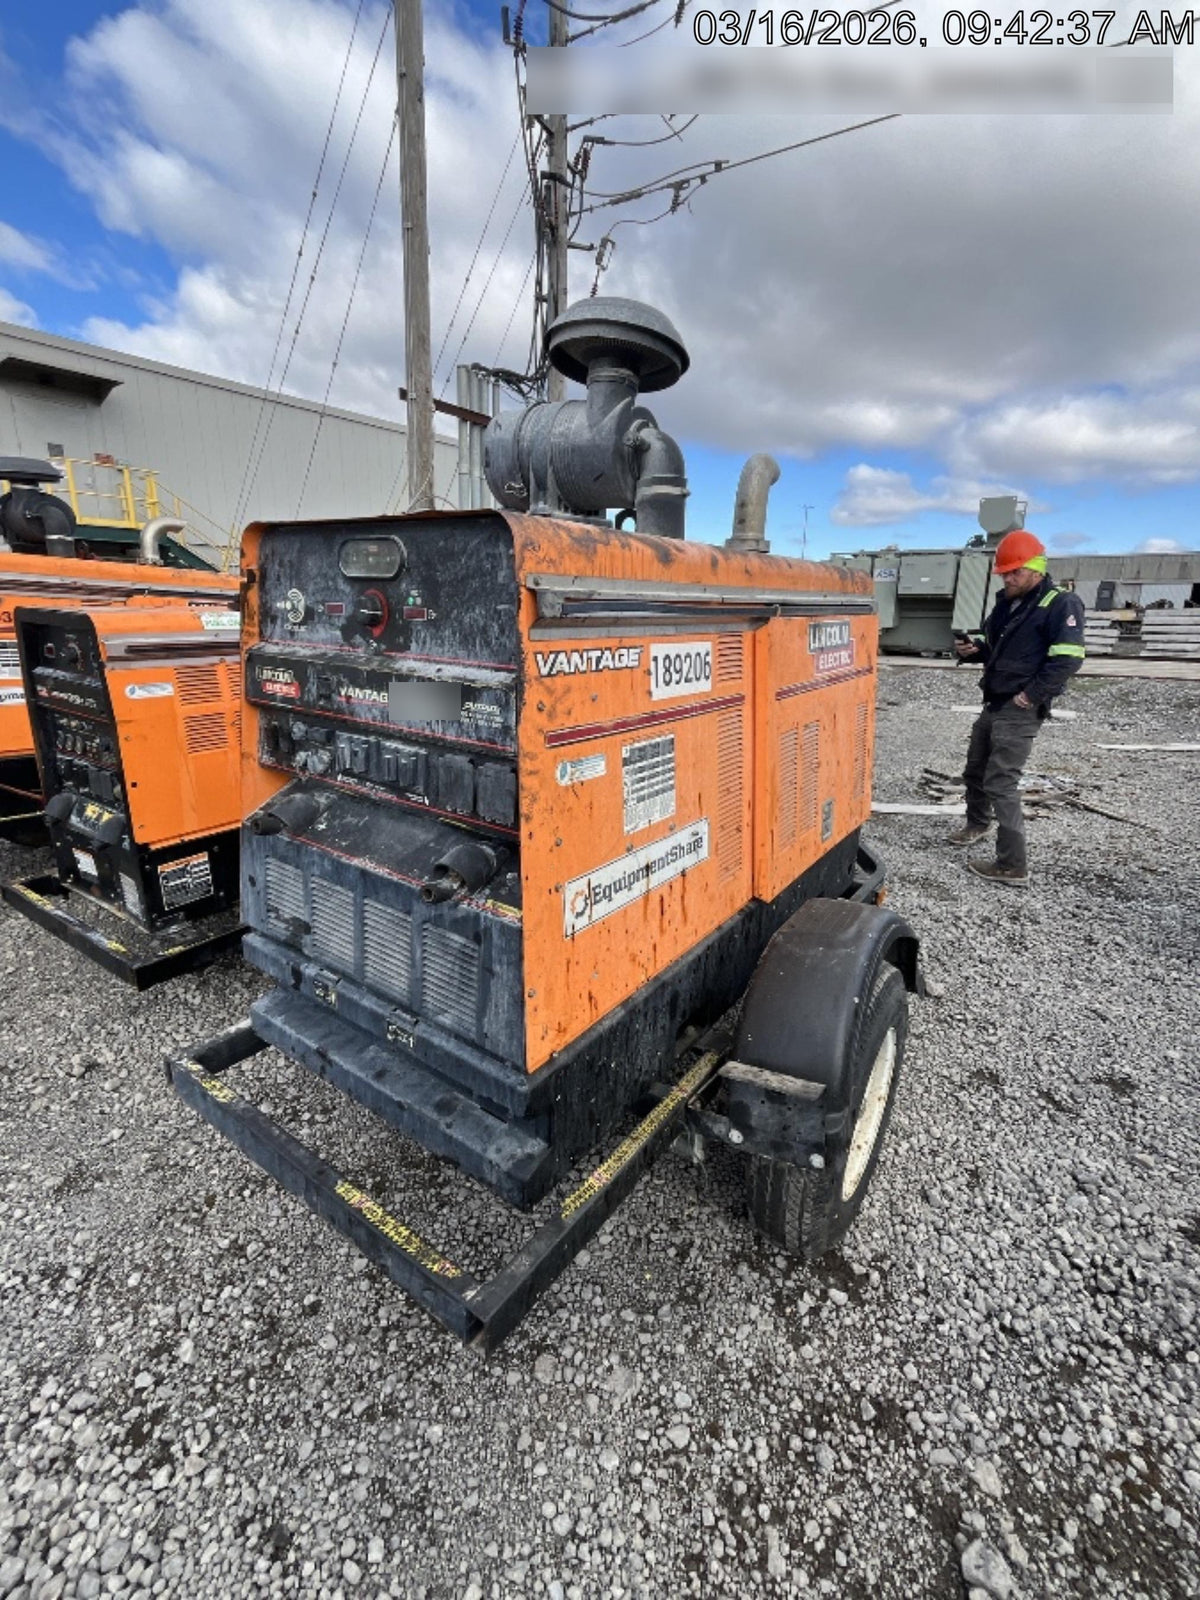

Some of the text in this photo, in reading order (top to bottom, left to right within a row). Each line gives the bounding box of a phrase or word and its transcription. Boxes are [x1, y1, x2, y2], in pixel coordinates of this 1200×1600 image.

[810, 623, 849, 650] LINCOLN
[534, 646, 643, 678] VANTAGE
[652, 651, 711, 688] 189206
[338, 686, 389, 703] VANTAG
[591, 836, 703, 906] EquipmentShare
